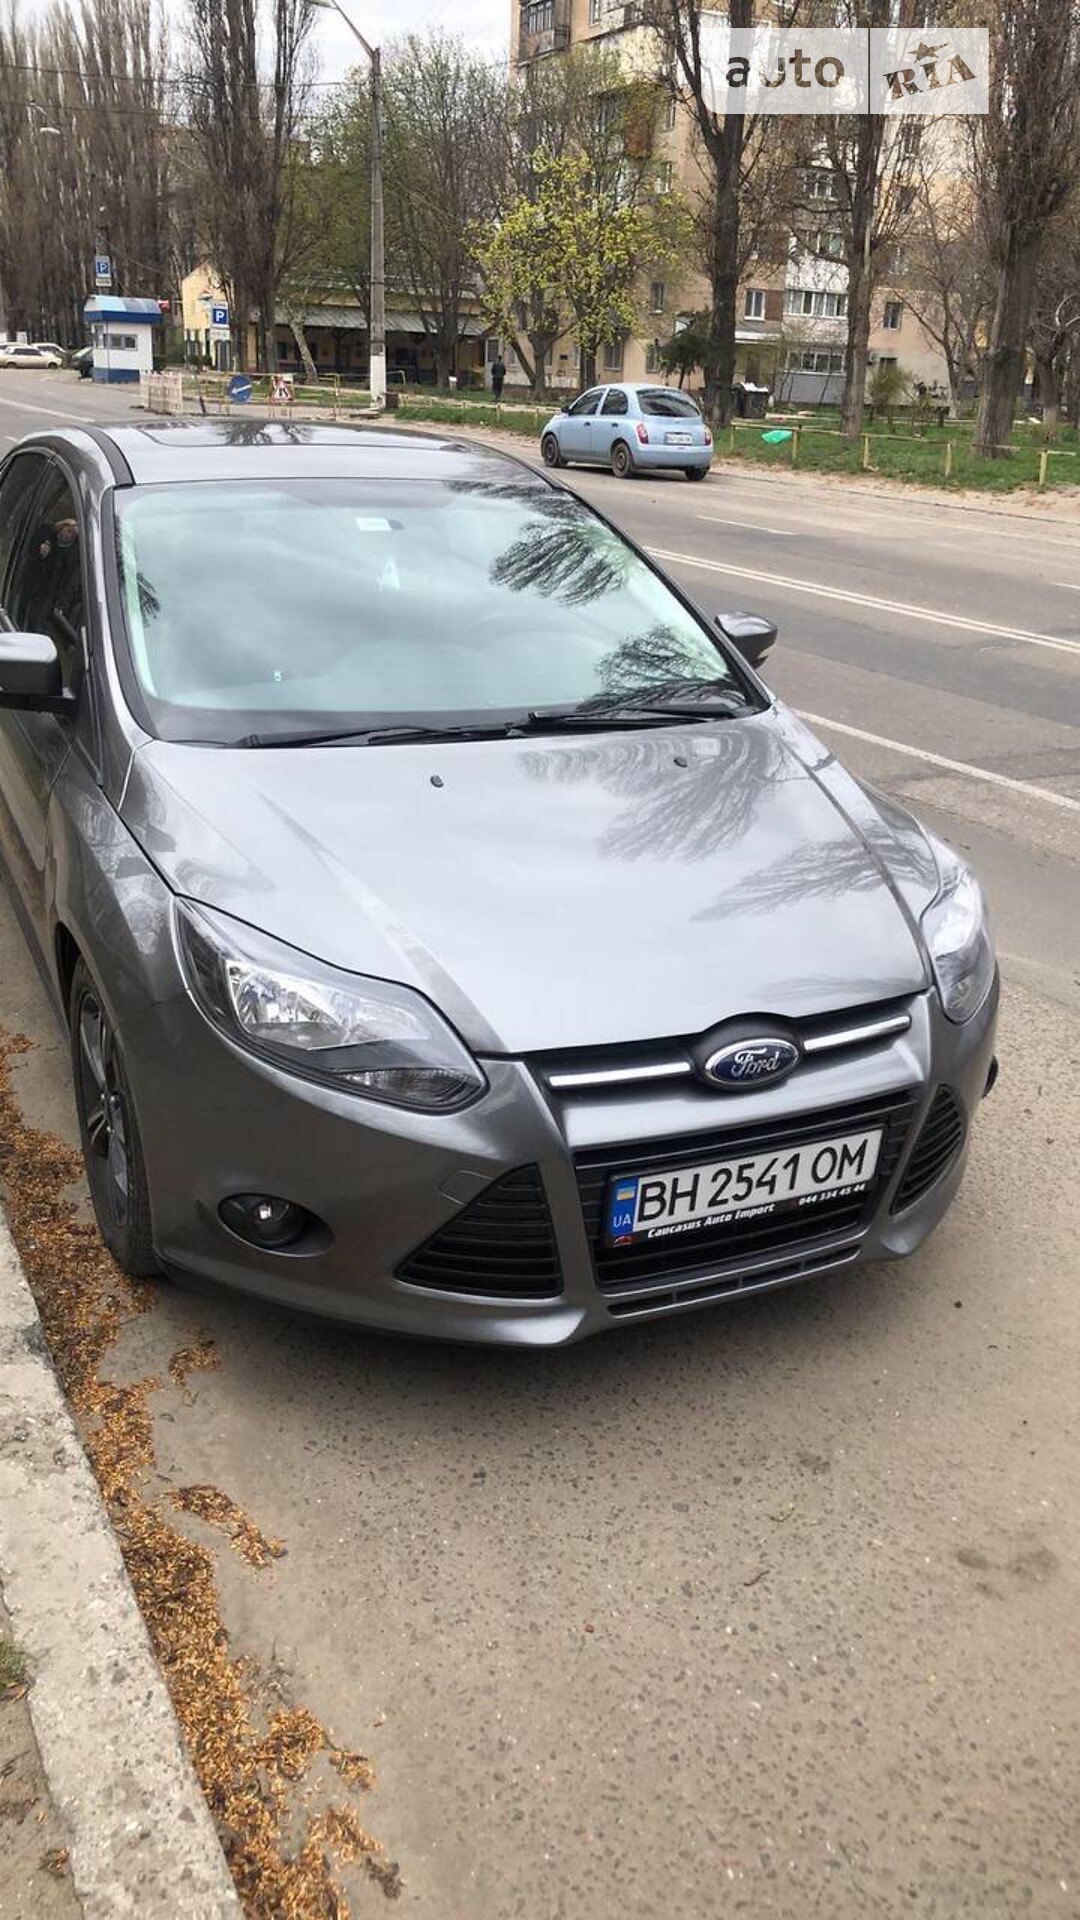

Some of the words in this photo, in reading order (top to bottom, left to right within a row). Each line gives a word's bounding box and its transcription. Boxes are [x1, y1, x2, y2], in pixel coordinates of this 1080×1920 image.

[215, 310, 225, 322] P
[731, 1048, 780, 1077] Ford
[637, 1174, 699, 1223] BH
[708, 1153, 801, 1208] 2541
[811, 1139, 868, 1183] OM
[612, 1214, 631, 1228] UA
[648, 1220, 702, 1238] Caucasus
[704, 1213, 733, 1227] Auto
[735, 1203, 776, 1220] Import
